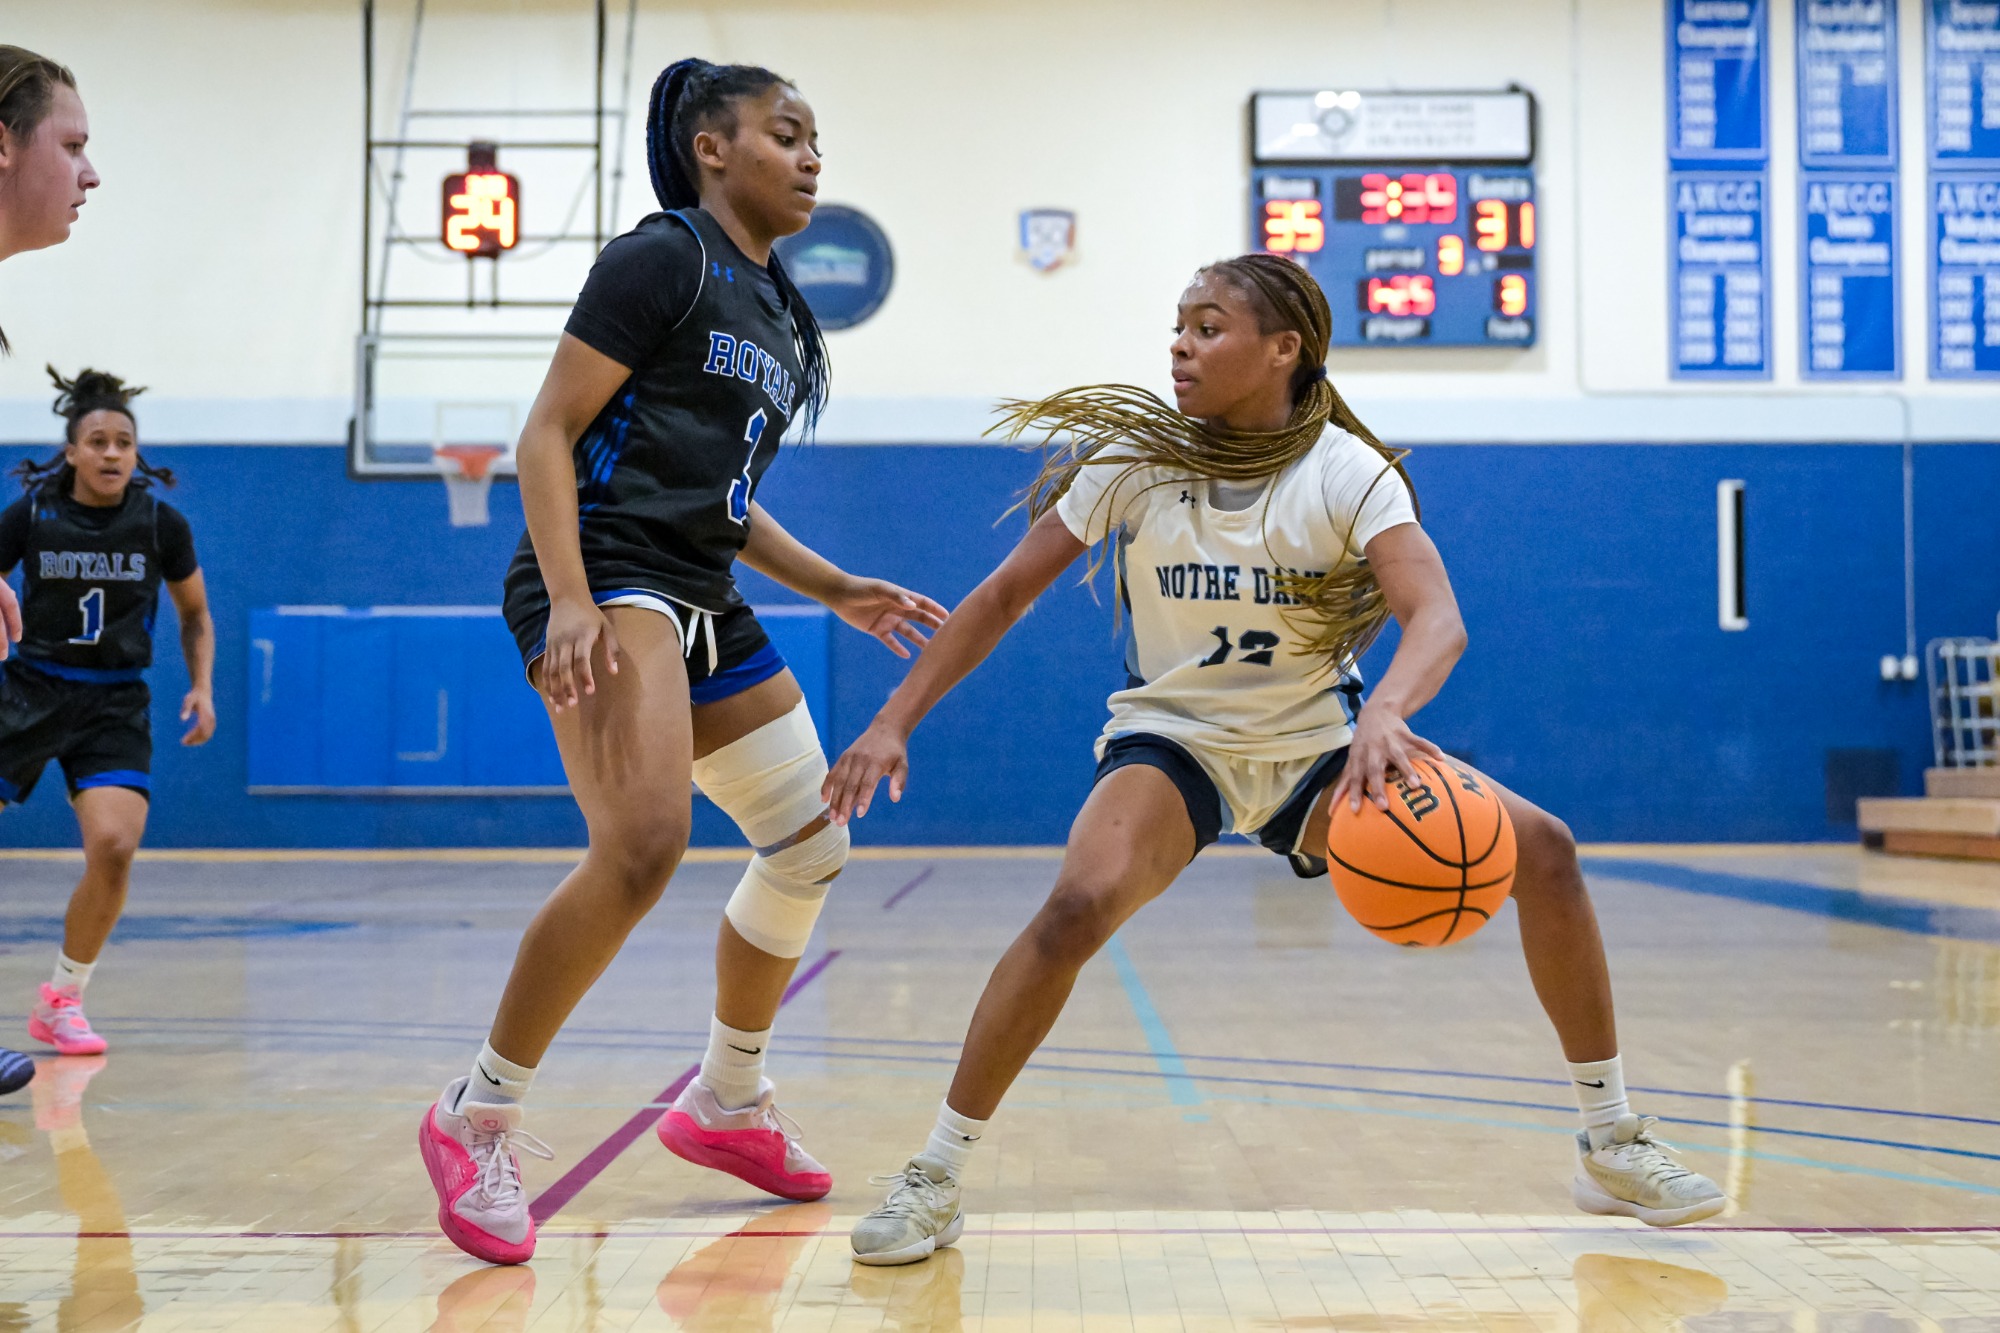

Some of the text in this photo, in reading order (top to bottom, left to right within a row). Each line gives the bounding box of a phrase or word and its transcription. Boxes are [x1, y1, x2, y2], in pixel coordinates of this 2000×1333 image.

[1264, 199, 1324, 253] 35
[1475, 199, 1535, 253] 31
[1437, 234, 1465, 277] 3
[1500, 274, 1528, 317] 3
[703, 331, 796, 422] ROYALS
[38, 550, 147, 582] ROYALS
[1156, 563, 1330, 606] NOTRE DA
[67, 586, 105, 646] 1
[1197, 625, 1281, 669] 12
